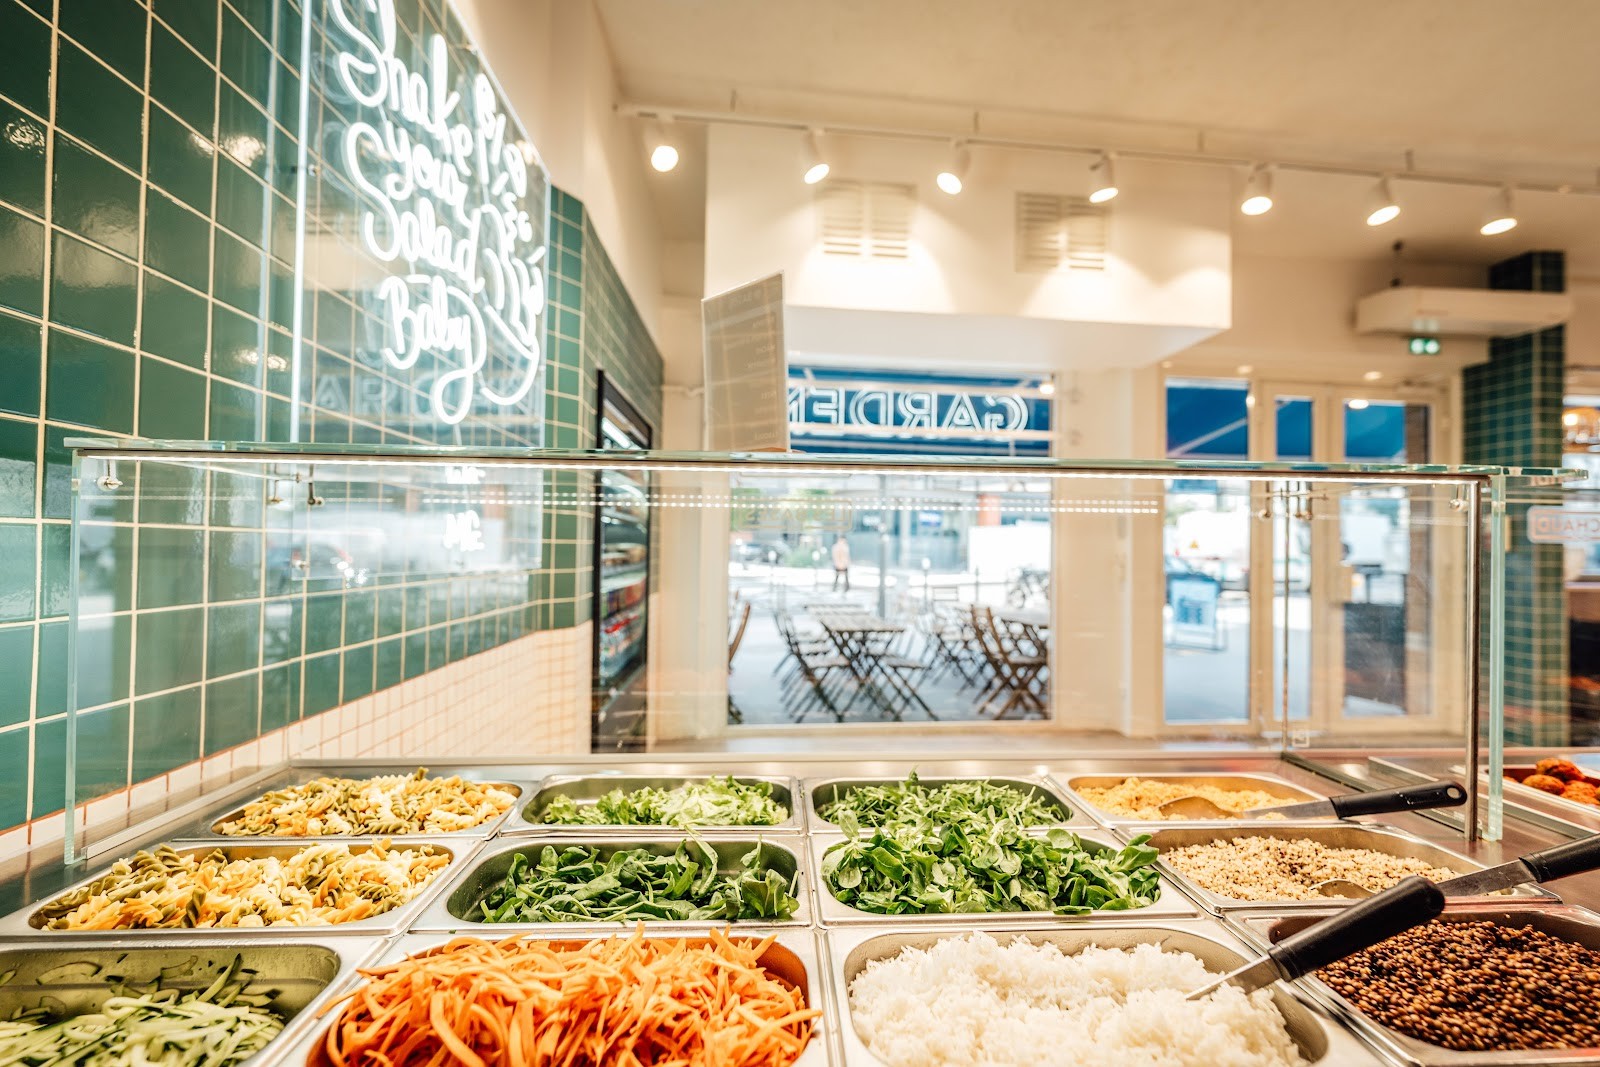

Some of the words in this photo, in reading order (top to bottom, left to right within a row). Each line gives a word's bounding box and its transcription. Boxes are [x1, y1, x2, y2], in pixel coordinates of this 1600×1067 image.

[330, 0, 474, 176] Shake
[346, 121, 486, 294] Salad
[383, 120, 472, 228] your
[377, 275, 488, 425] Baby
